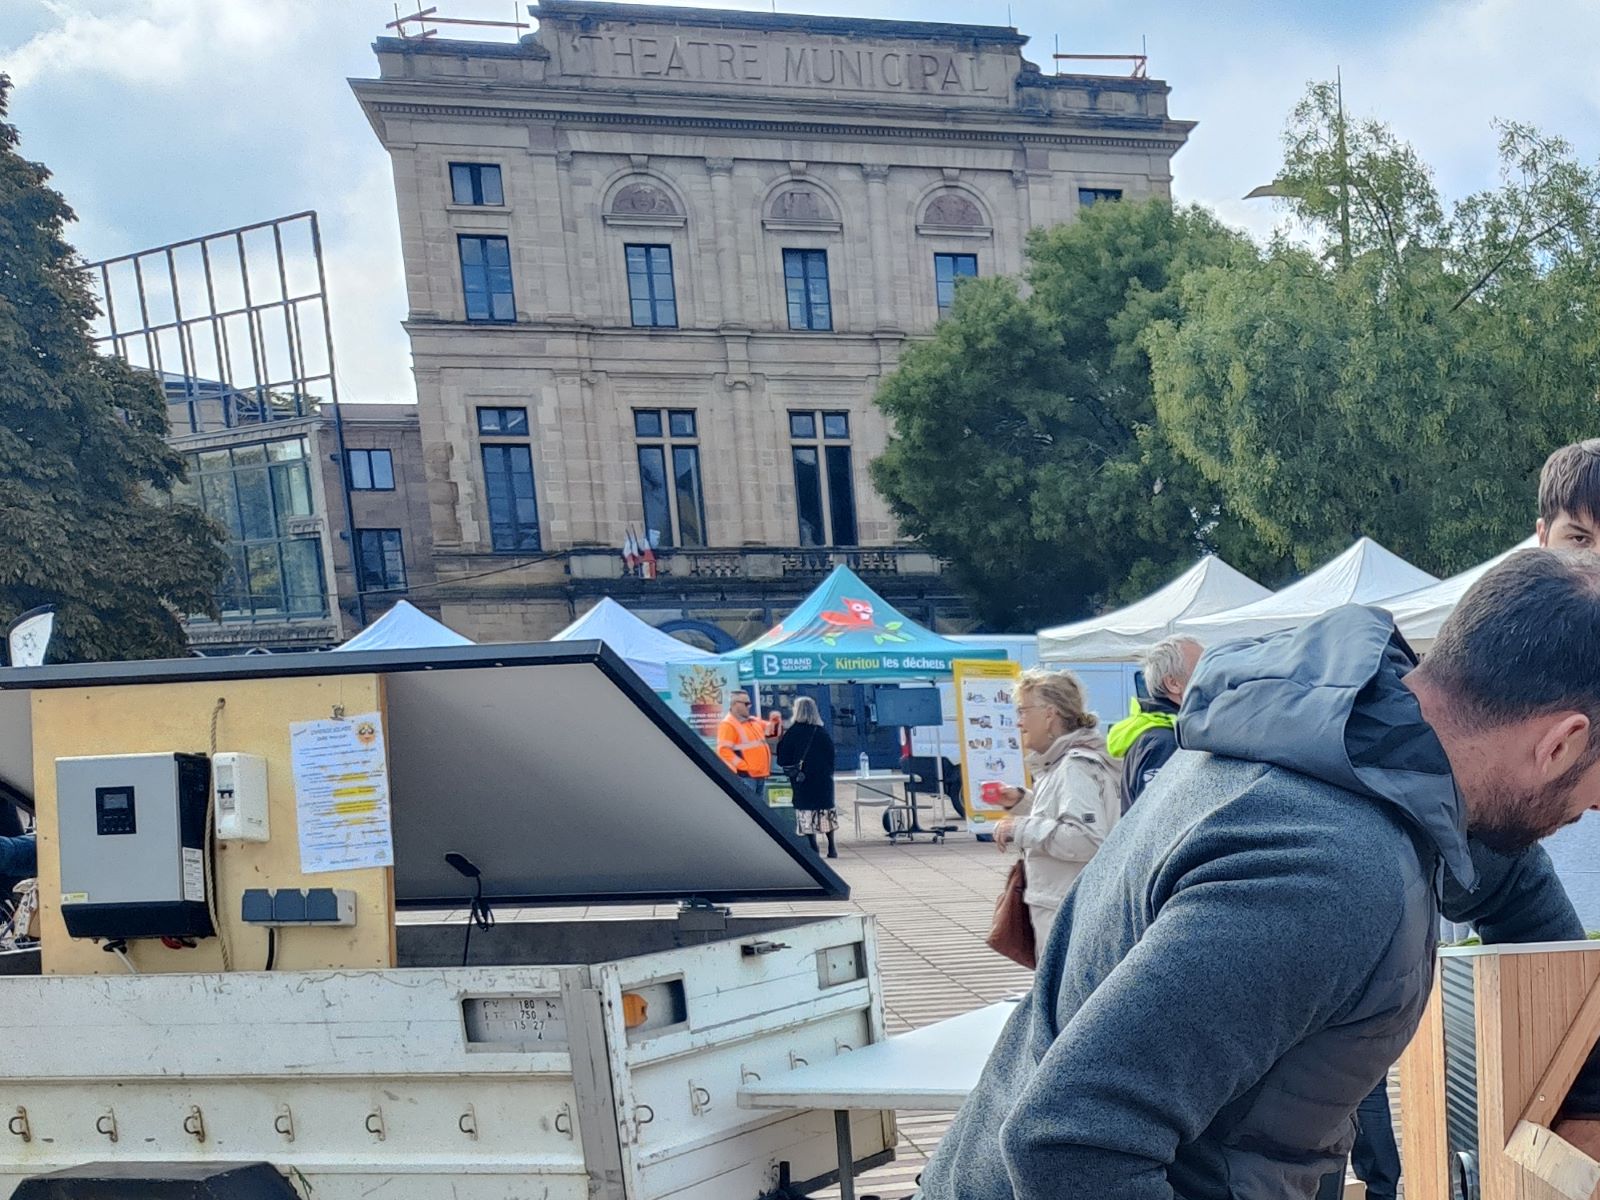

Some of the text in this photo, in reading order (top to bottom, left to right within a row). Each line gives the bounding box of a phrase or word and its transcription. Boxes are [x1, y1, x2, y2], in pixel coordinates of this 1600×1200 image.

[784, 46, 989, 93] MUNICIPAL
[780, 658, 812, 666] GRAND
[835, 656, 879, 670] Kitritou
[883, 656, 899, 669] les
[902, 655, 946, 670] déchets
[519, 1000, 535, 1009] 180
